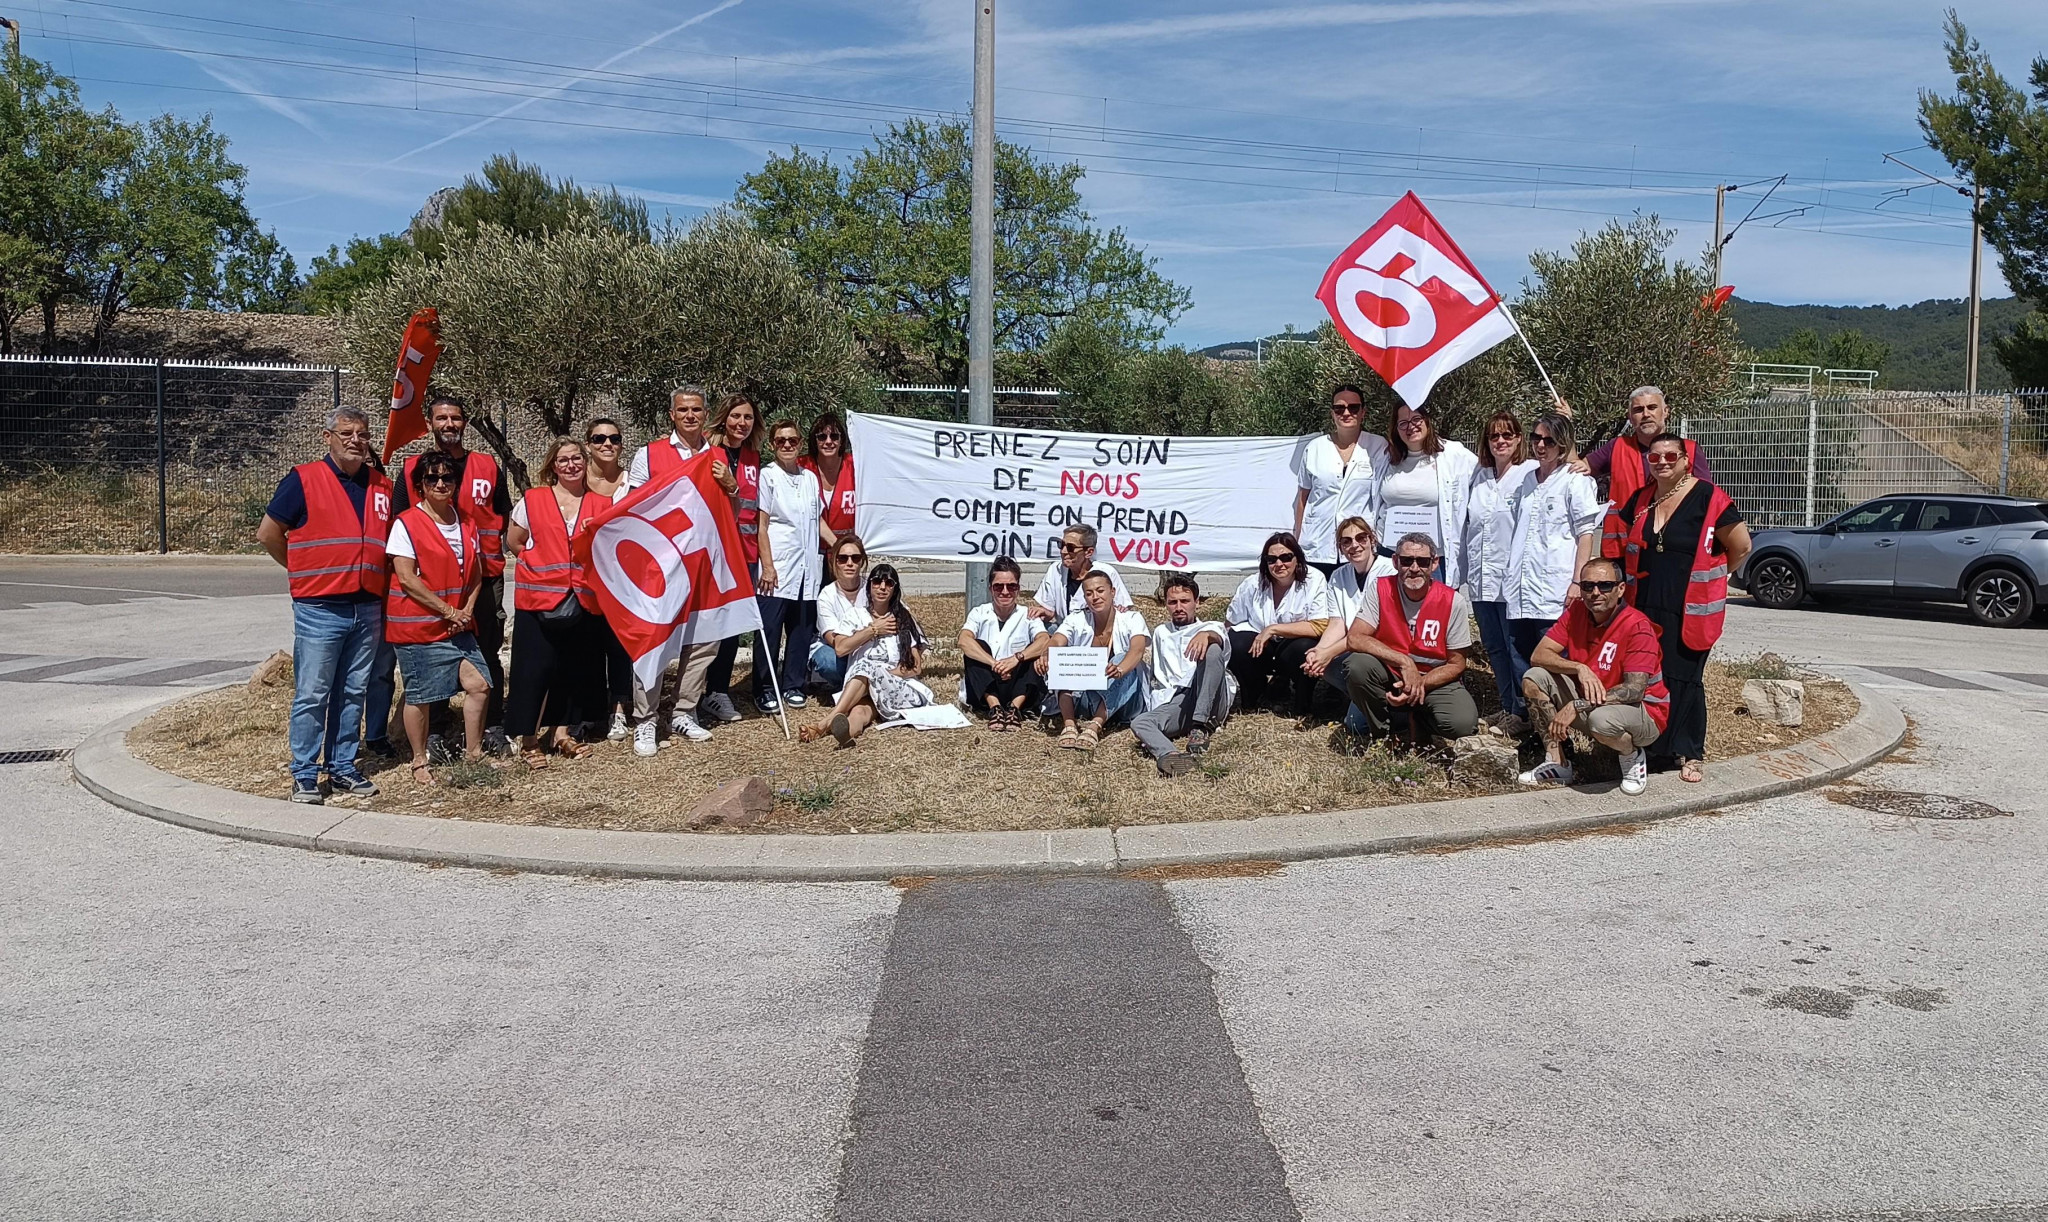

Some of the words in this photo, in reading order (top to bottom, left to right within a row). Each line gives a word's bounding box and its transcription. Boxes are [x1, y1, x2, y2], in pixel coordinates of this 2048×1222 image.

[934, 430, 1060, 461] PRENEZ
[744, 465, 757, 482] FO
[993, 467, 1037, 492] DE
[1060, 470, 1141, 500] NOUS
[472, 478, 491, 498] FO
[374, 492, 390, 515] FO
[932, 498, 1036, 527] COMME
[1048, 505, 1082, 526] ON
[1097, 501, 1188, 535] PREND
[1046, 536, 1062, 559] D
[1109, 538, 1190, 567] VOUS
[1421, 619, 1441, 641] FO
[1423, 640, 1438, 648] VAR
[1597, 641, 1618, 664] FO
[1598, 660, 1612, 671] VAR
